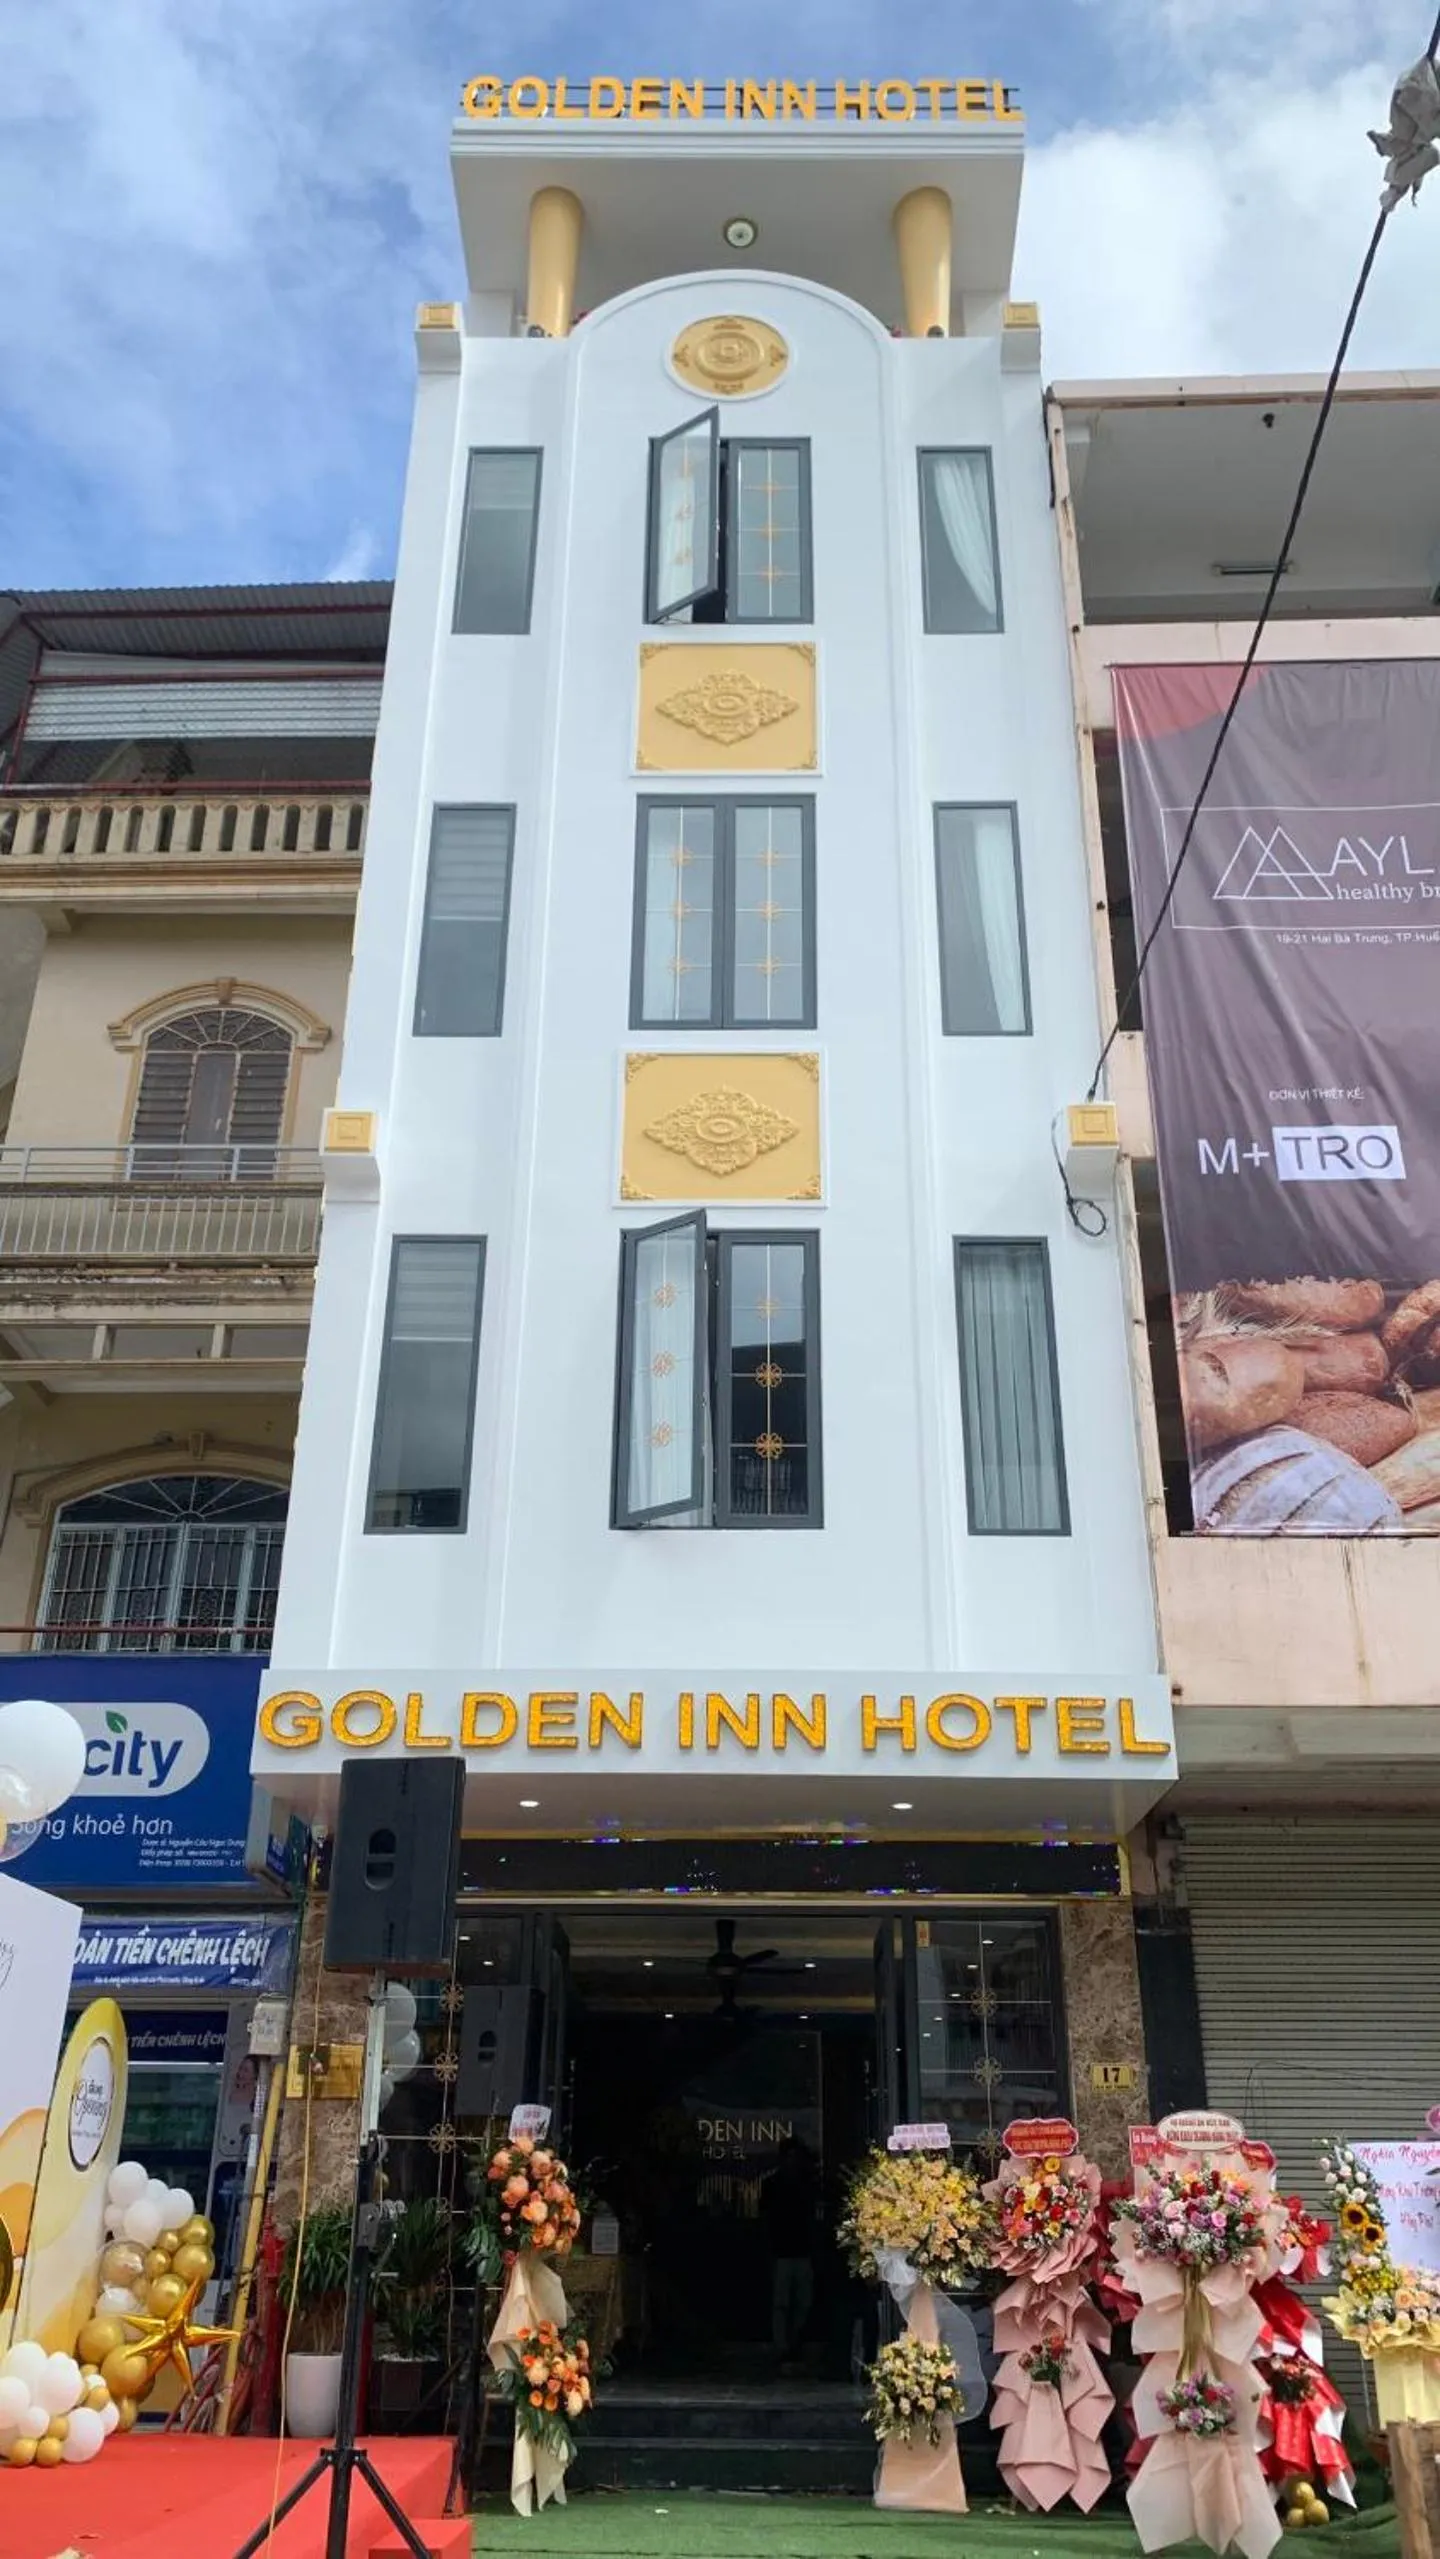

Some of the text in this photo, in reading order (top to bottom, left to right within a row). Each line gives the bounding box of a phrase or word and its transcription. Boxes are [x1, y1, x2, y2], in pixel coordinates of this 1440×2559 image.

[463, 76, 1026, 122] GOLDEN INN HOTEL
[1336, 881, 1414, 904] healthy
[1312, 933, 1332, 944] Hai
[258, 1689, 1171, 1754] GOLDEN INN HOTEL
[132, 1815, 174, 1835] hơn
[155, 1928, 222, 1966] CHÊNH
[219, 1927, 271, 1975] LỆCH
[1103, 2067, 1121, 2083] 17
[751, 2119, 793, 2142] INN
